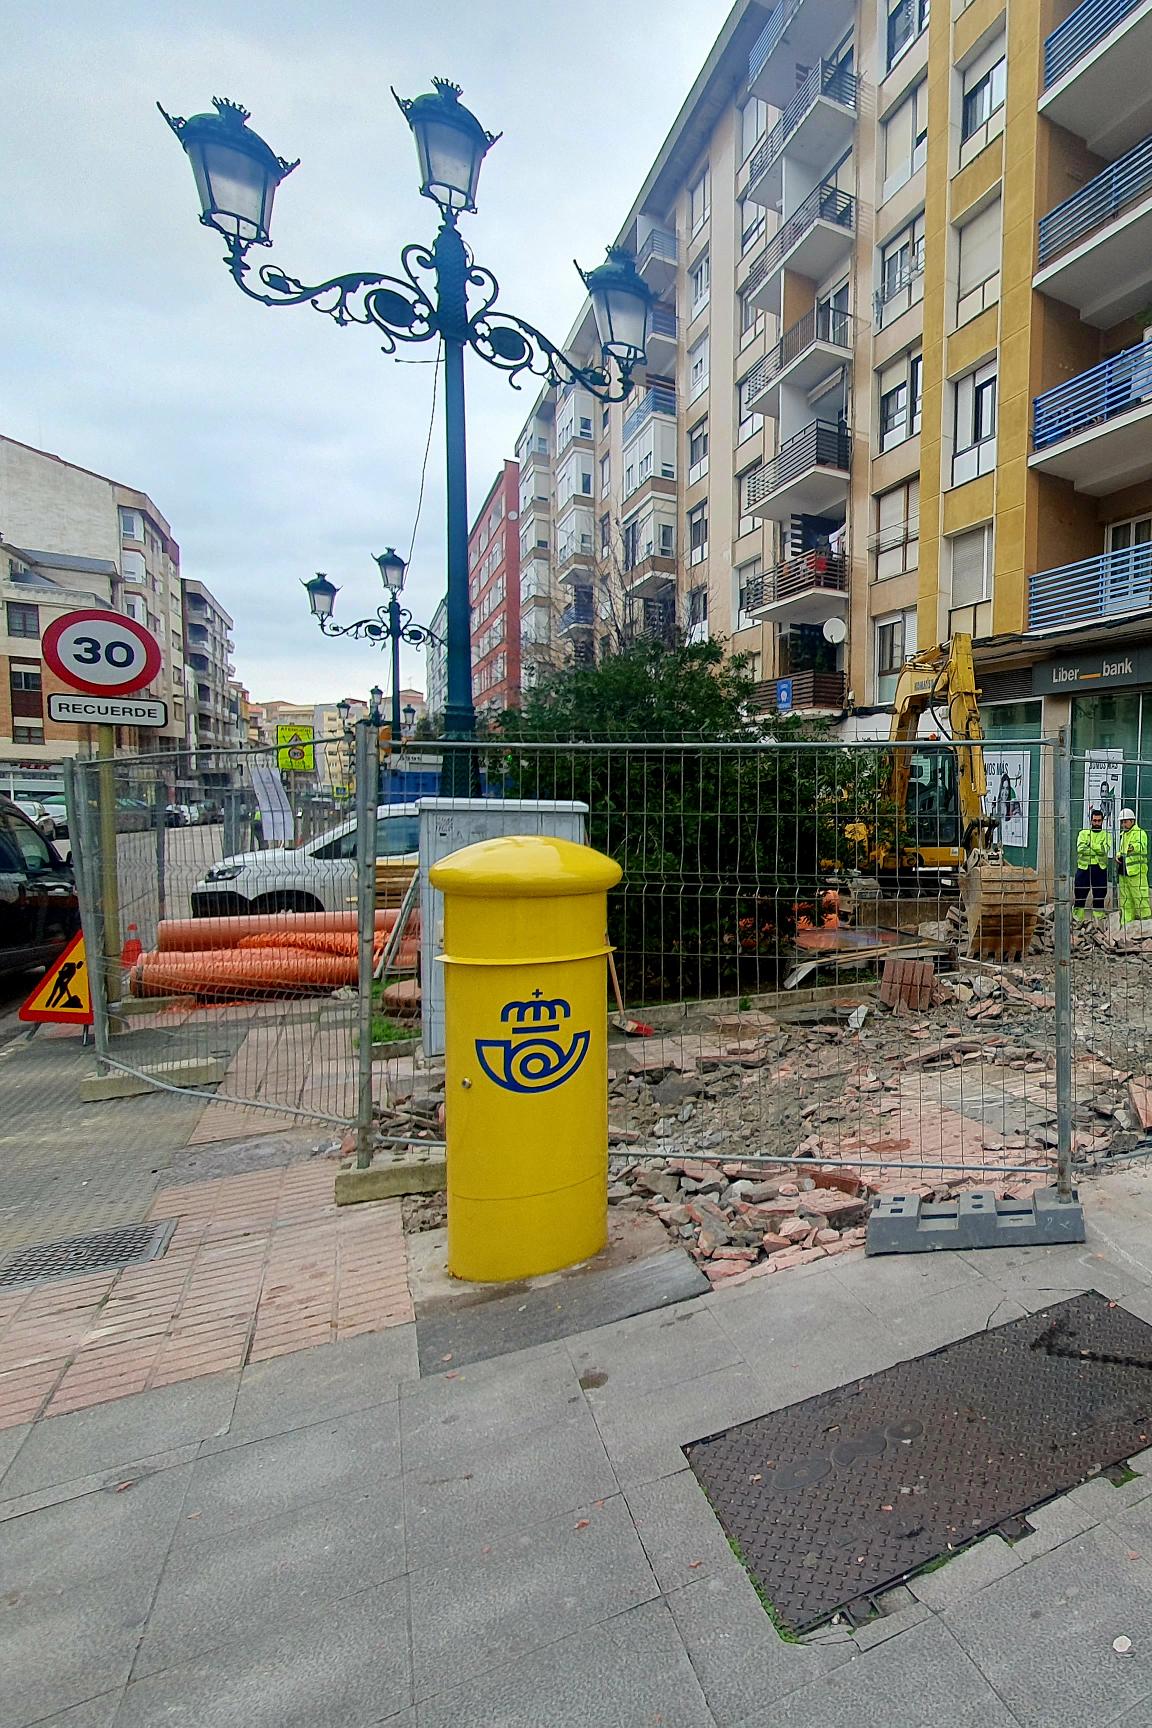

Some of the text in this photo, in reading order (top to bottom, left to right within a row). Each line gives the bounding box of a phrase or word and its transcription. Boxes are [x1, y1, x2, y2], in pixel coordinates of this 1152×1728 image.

[73, 637, 135, 668] 30
[1052, 658, 1133, 683] Liber bank
[58, 703, 158, 718] RECUERDE
